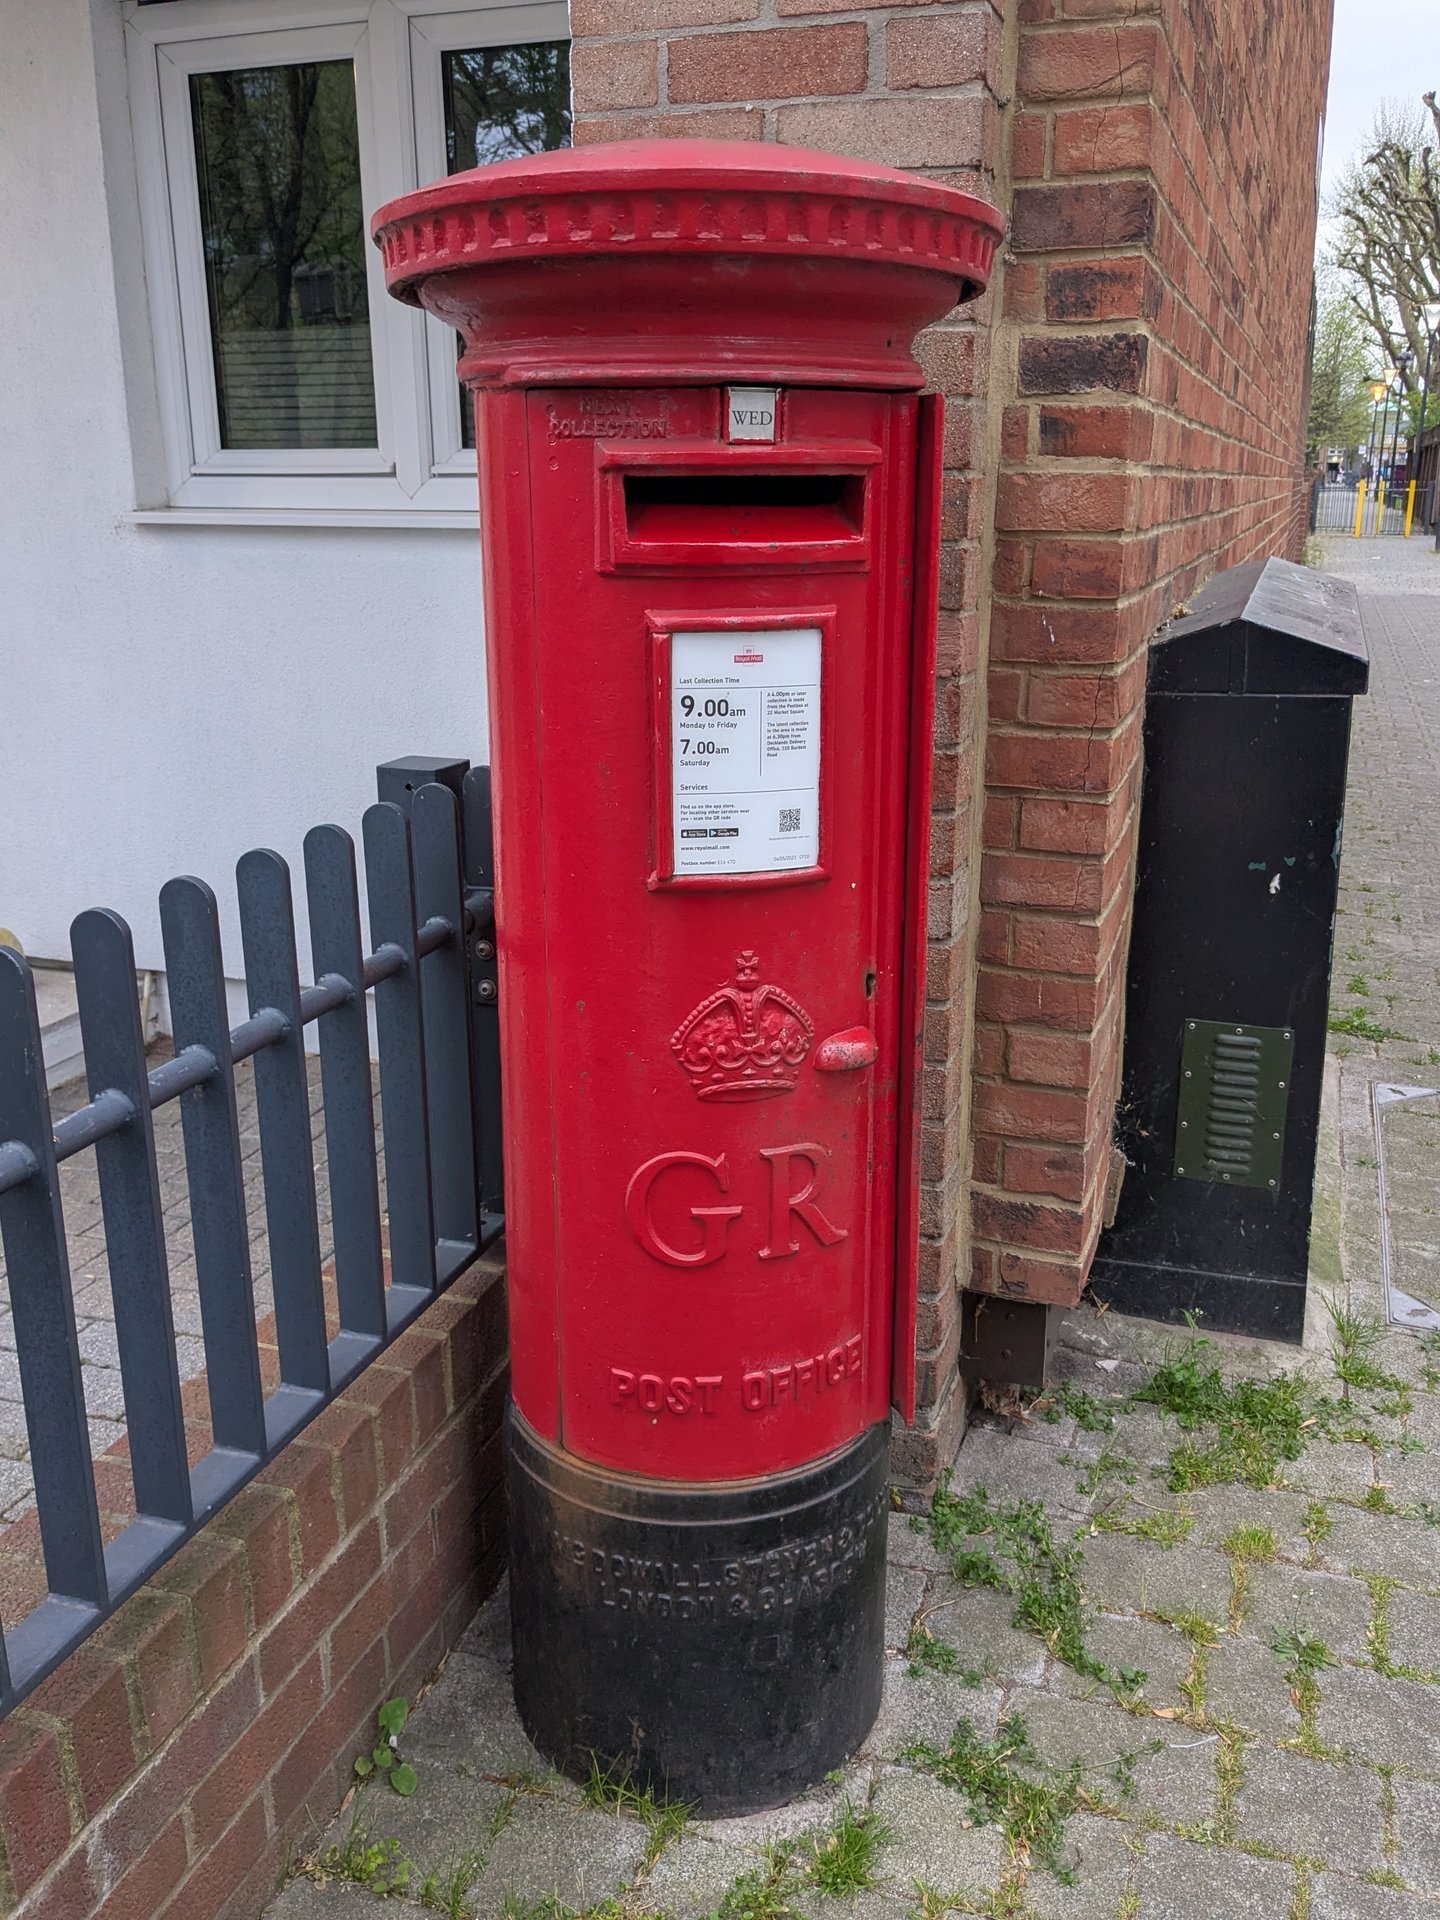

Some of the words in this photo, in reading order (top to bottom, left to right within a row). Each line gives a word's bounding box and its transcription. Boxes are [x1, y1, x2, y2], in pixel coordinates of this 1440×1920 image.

[732, 410, 773, 426] WED
[552, 419, 669, 440] COLLECTION
[680, 695, 746, 717] 9.00am
[680, 739, 729, 754] 7.00am
[610, 1367, 722, 1413] POST
[742, 1333, 861, 1411] OFFICE
